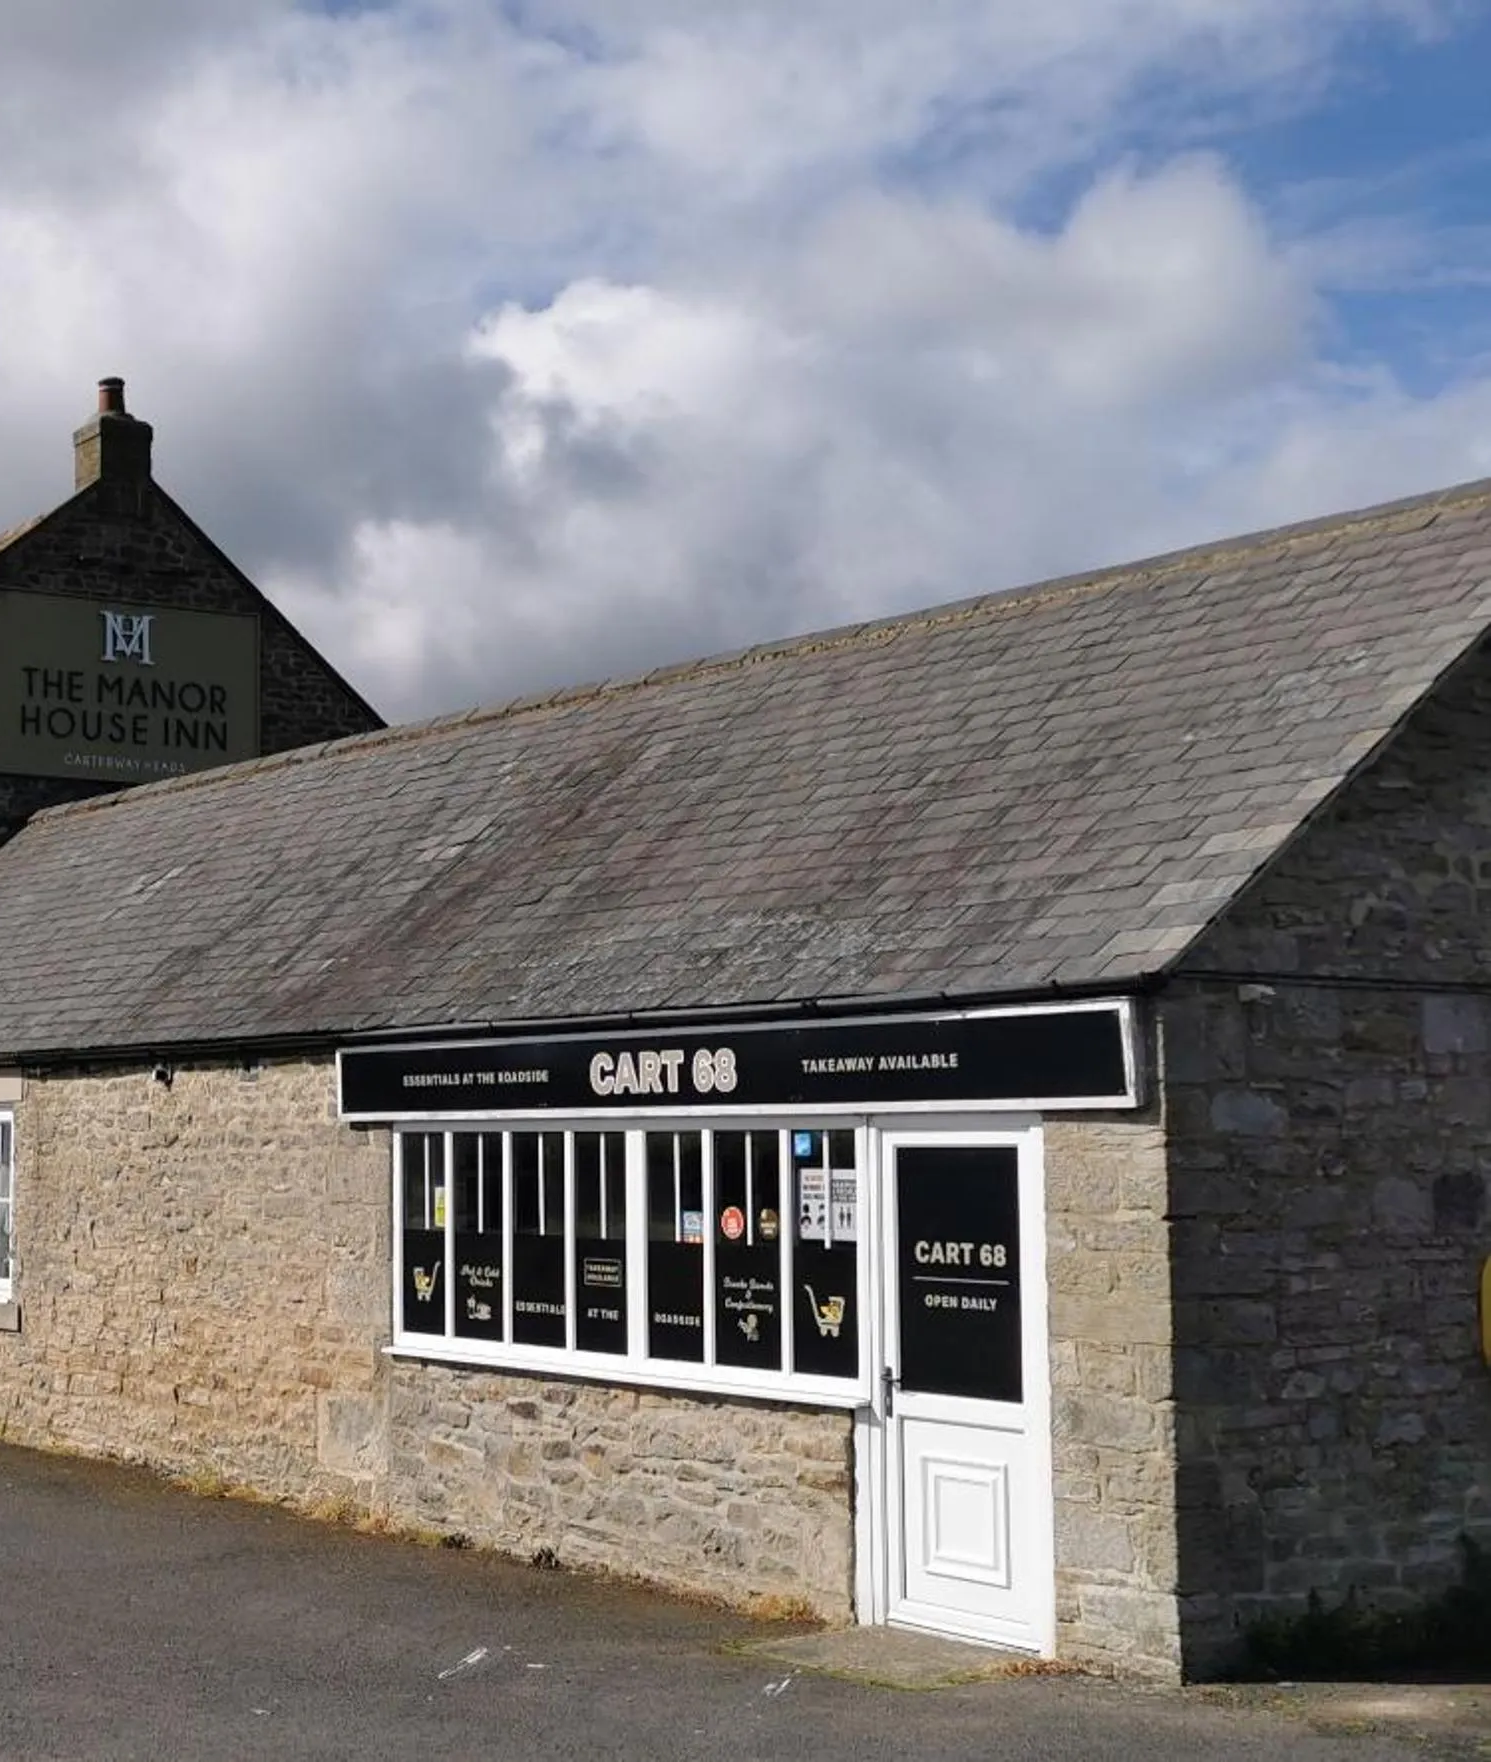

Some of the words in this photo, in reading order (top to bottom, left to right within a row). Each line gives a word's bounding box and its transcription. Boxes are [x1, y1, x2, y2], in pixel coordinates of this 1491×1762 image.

[21, 666, 84, 703] THE
[98, 672, 227, 716] MANOR
[20, 704, 148, 746] HOUSE
[164, 716, 228, 752] INN
[589, 1050, 685, 1096] CART
[692, 1047, 738, 1093] 68
[801, 1056, 874, 1073] TAKEAWAY
[878, 1053, 959, 1071] AVAILABLE
[402, 1072, 460, 1087] ESSENTIALS
[462, 1072, 475, 1086] AT
[476, 1071, 496, 1085] THE
[497, 1068, 550, 1084] ROADSIDE
[914, 1240, 975, 1266] CART
[979, 1243, 1007, 1268] 68
[600, 1309, 619, 1321] THE
[924, 1294, 959, 1308] OPEN
[961, 1295, 997, 1312] DAILY
